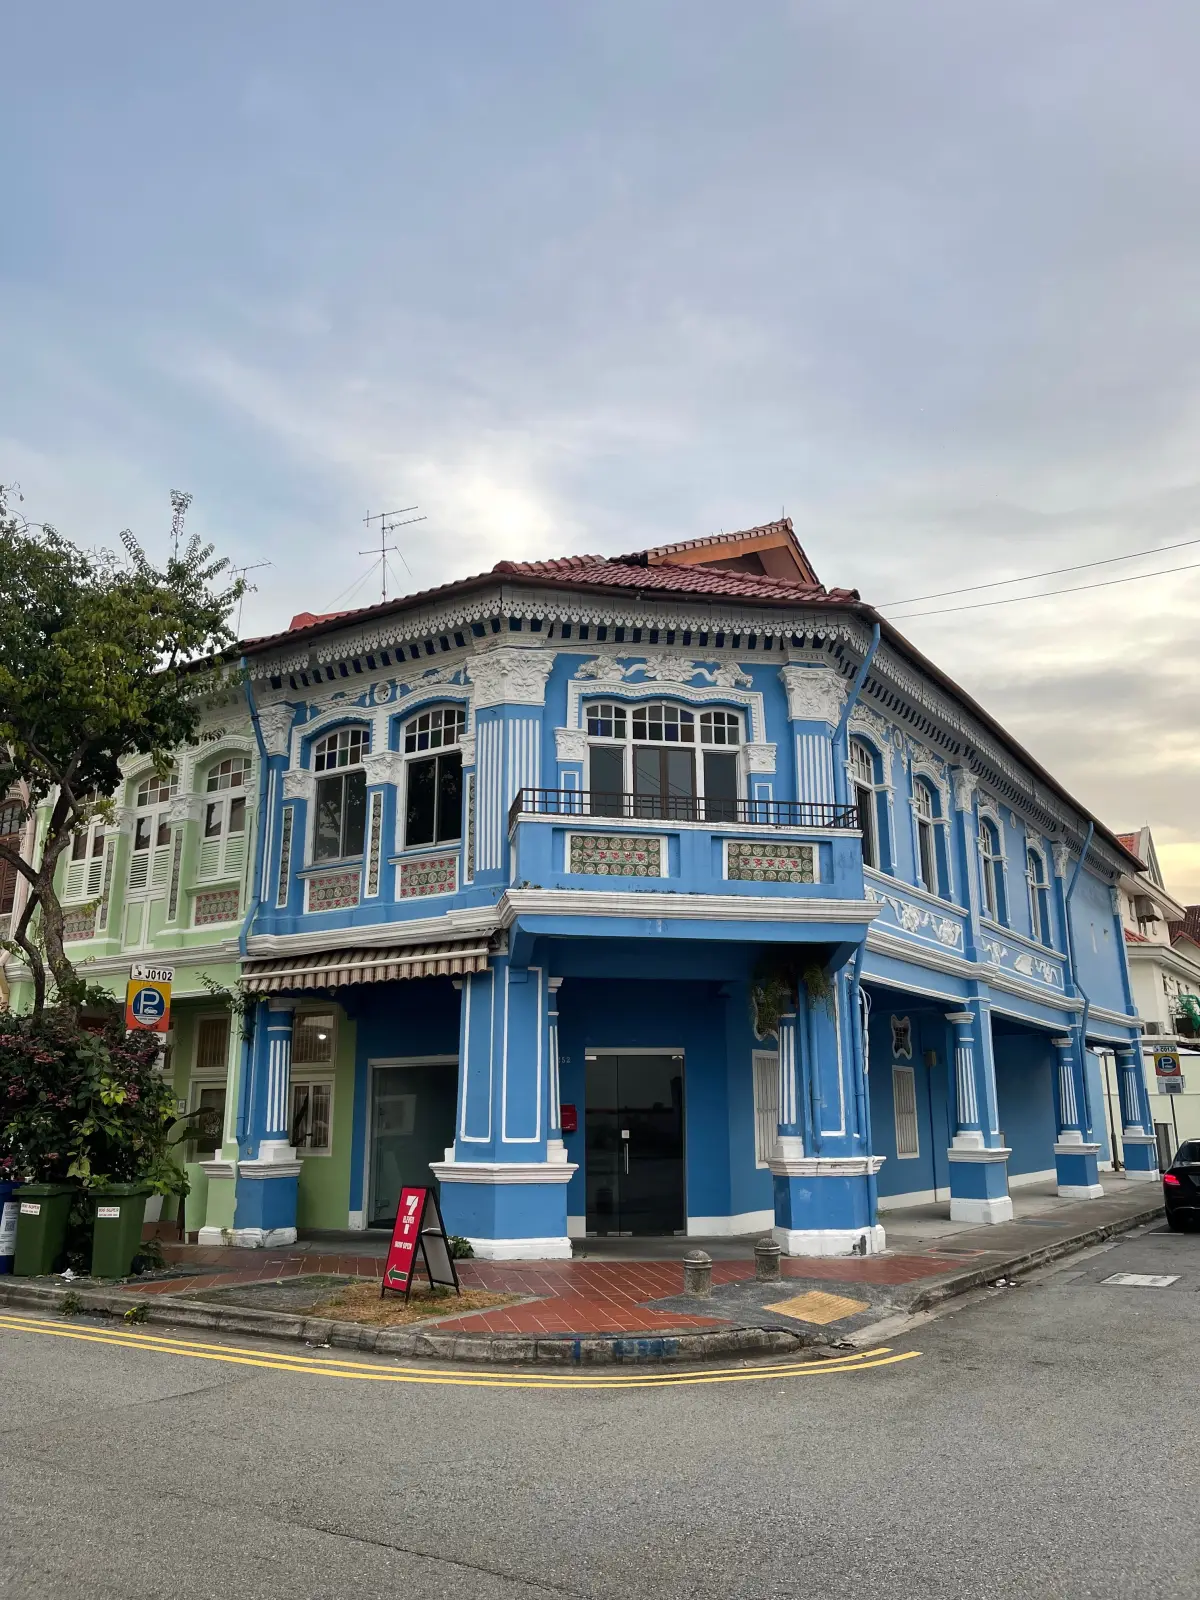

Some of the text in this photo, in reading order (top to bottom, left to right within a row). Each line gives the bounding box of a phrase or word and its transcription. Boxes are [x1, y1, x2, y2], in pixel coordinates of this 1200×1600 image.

[146, 970, 173, 981] J0102
[140, 991, 160, 1014] P
[1161, 1056, 1173, 1069] P
